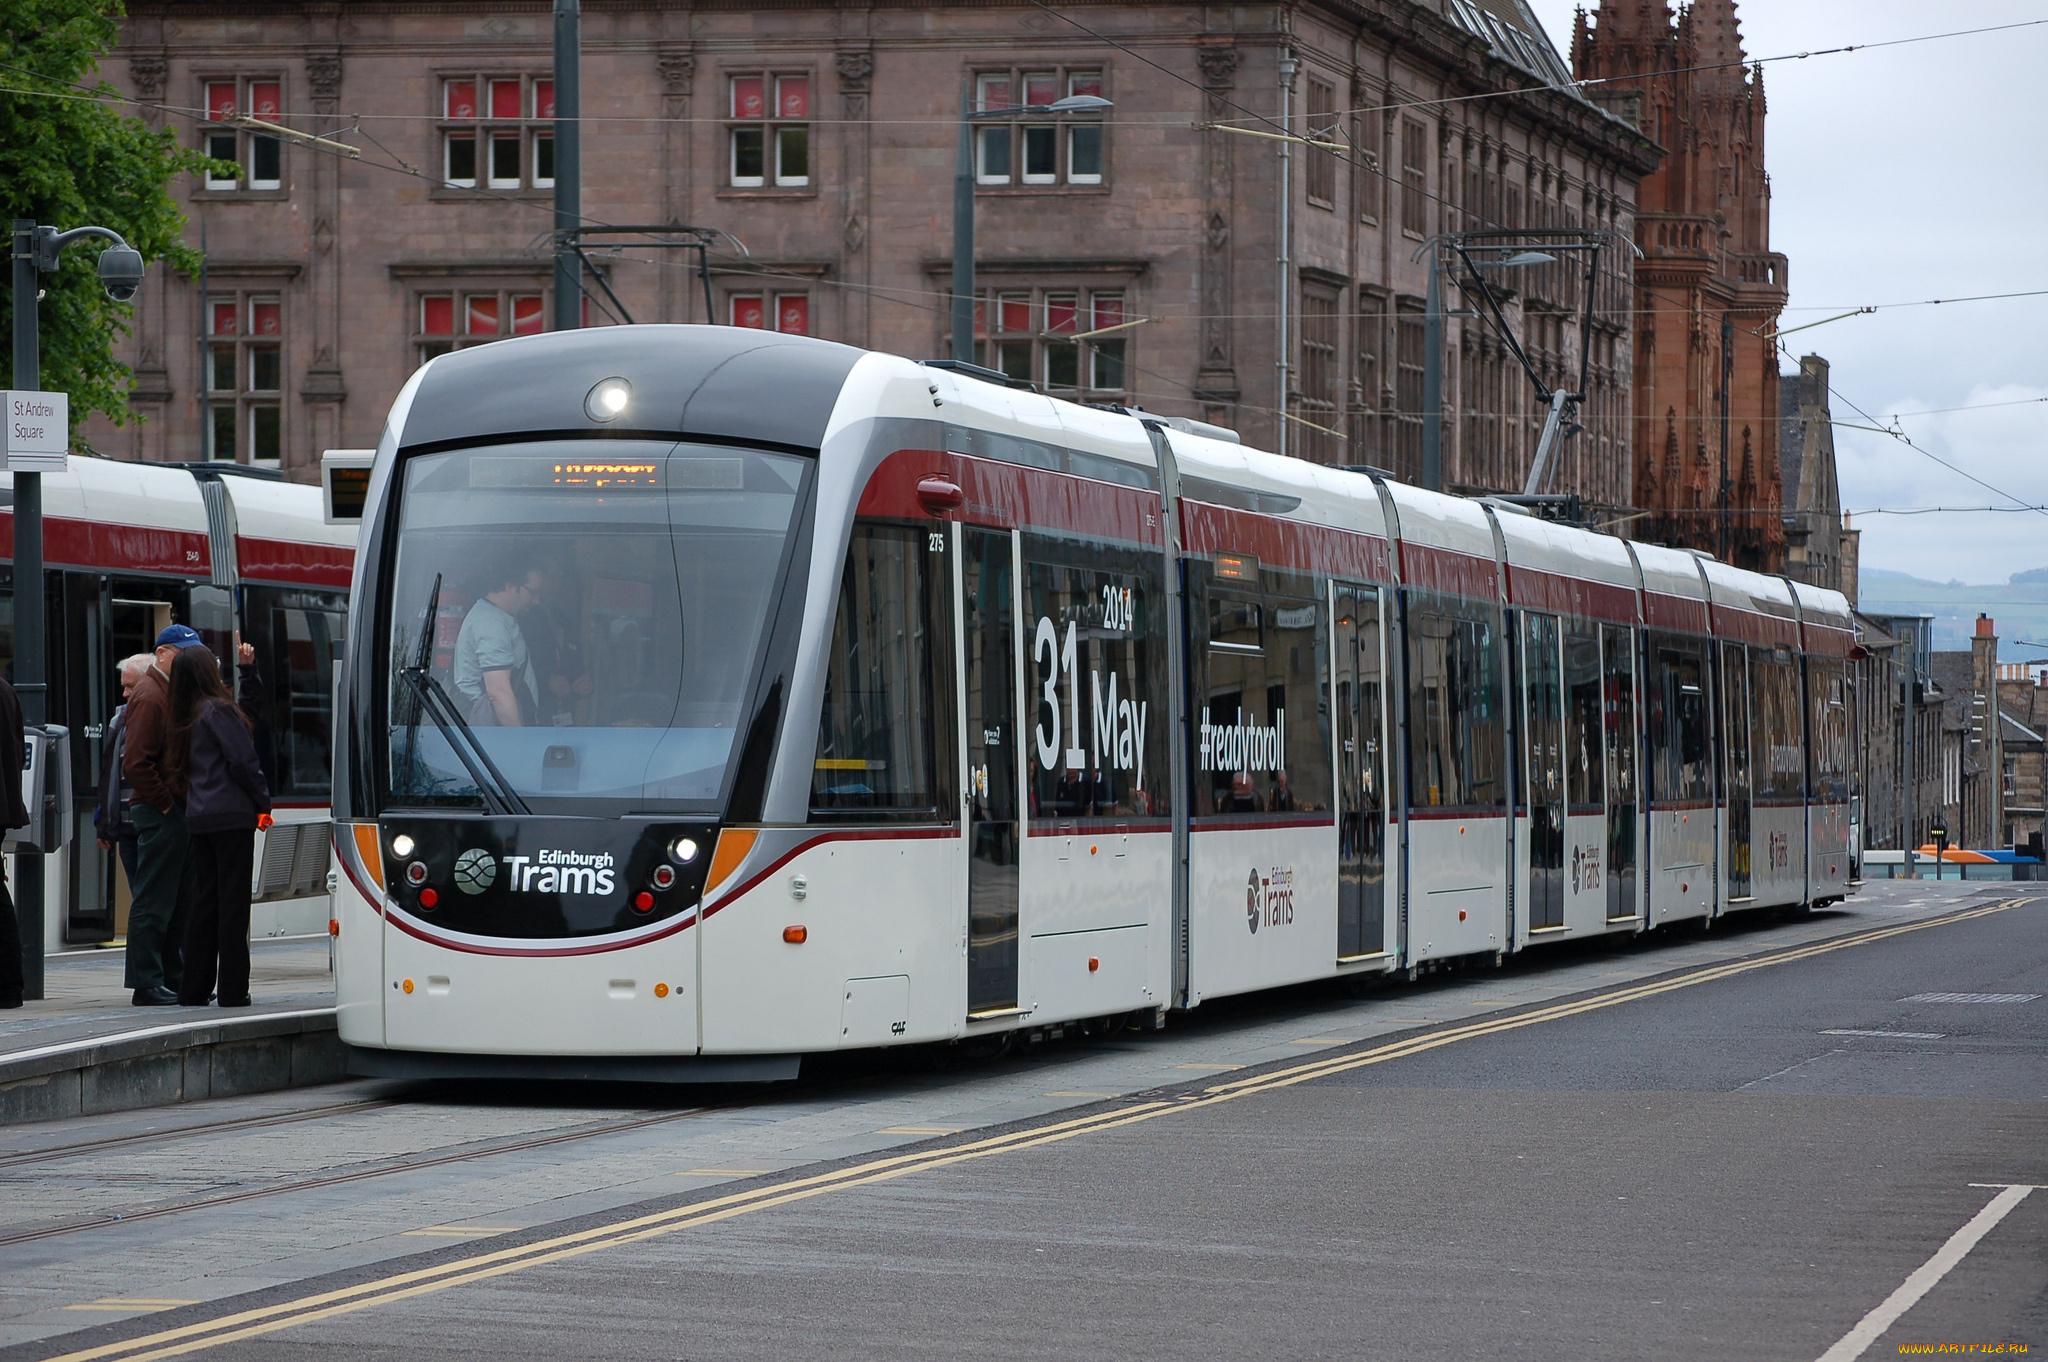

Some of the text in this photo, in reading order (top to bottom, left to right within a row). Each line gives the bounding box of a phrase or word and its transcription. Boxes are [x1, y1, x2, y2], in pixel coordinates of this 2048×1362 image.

[14, 400, 54, 417] St Andrew
[14, 422, 44, 441] Square
[929, 532, 944, 552] 275
[1103, 584, 1133, 631] 2014
[1035, 616, 1147, 791] 31 May
[1200, 706, 1284, 785] #readytoroll
[502, 856, 615, 895] Trams
[538, 849, 614, 869] Edinburgh
[1581, 852, 1600, 890] Trams
[1262, 878, 1294, 927] Trams
